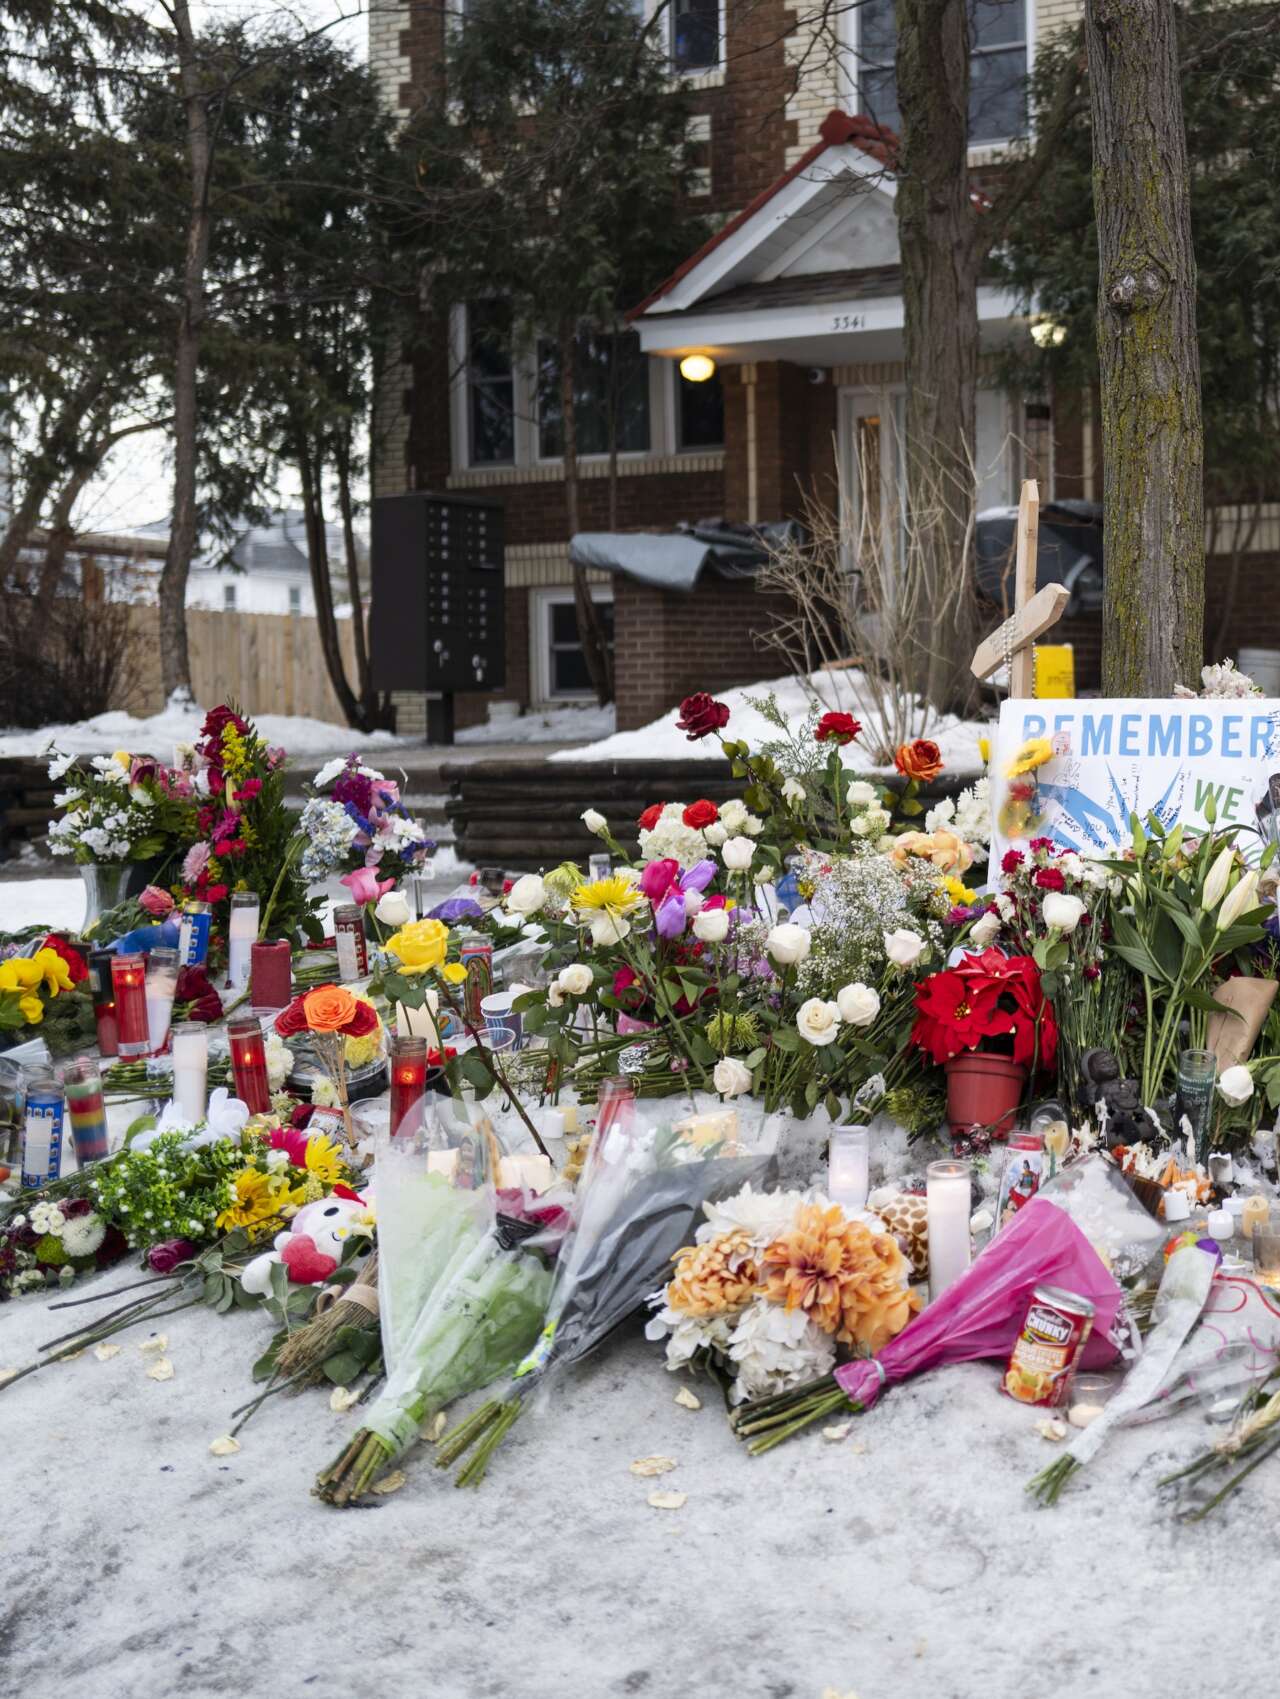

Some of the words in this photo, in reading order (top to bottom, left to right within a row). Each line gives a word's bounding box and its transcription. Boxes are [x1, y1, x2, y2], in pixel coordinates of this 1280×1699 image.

[1022, 714, 1275, 758] REMEMBER
[1194, 779, 1244, 821] WE
[1027, 1312, 1069, 1340] CHUNKY
